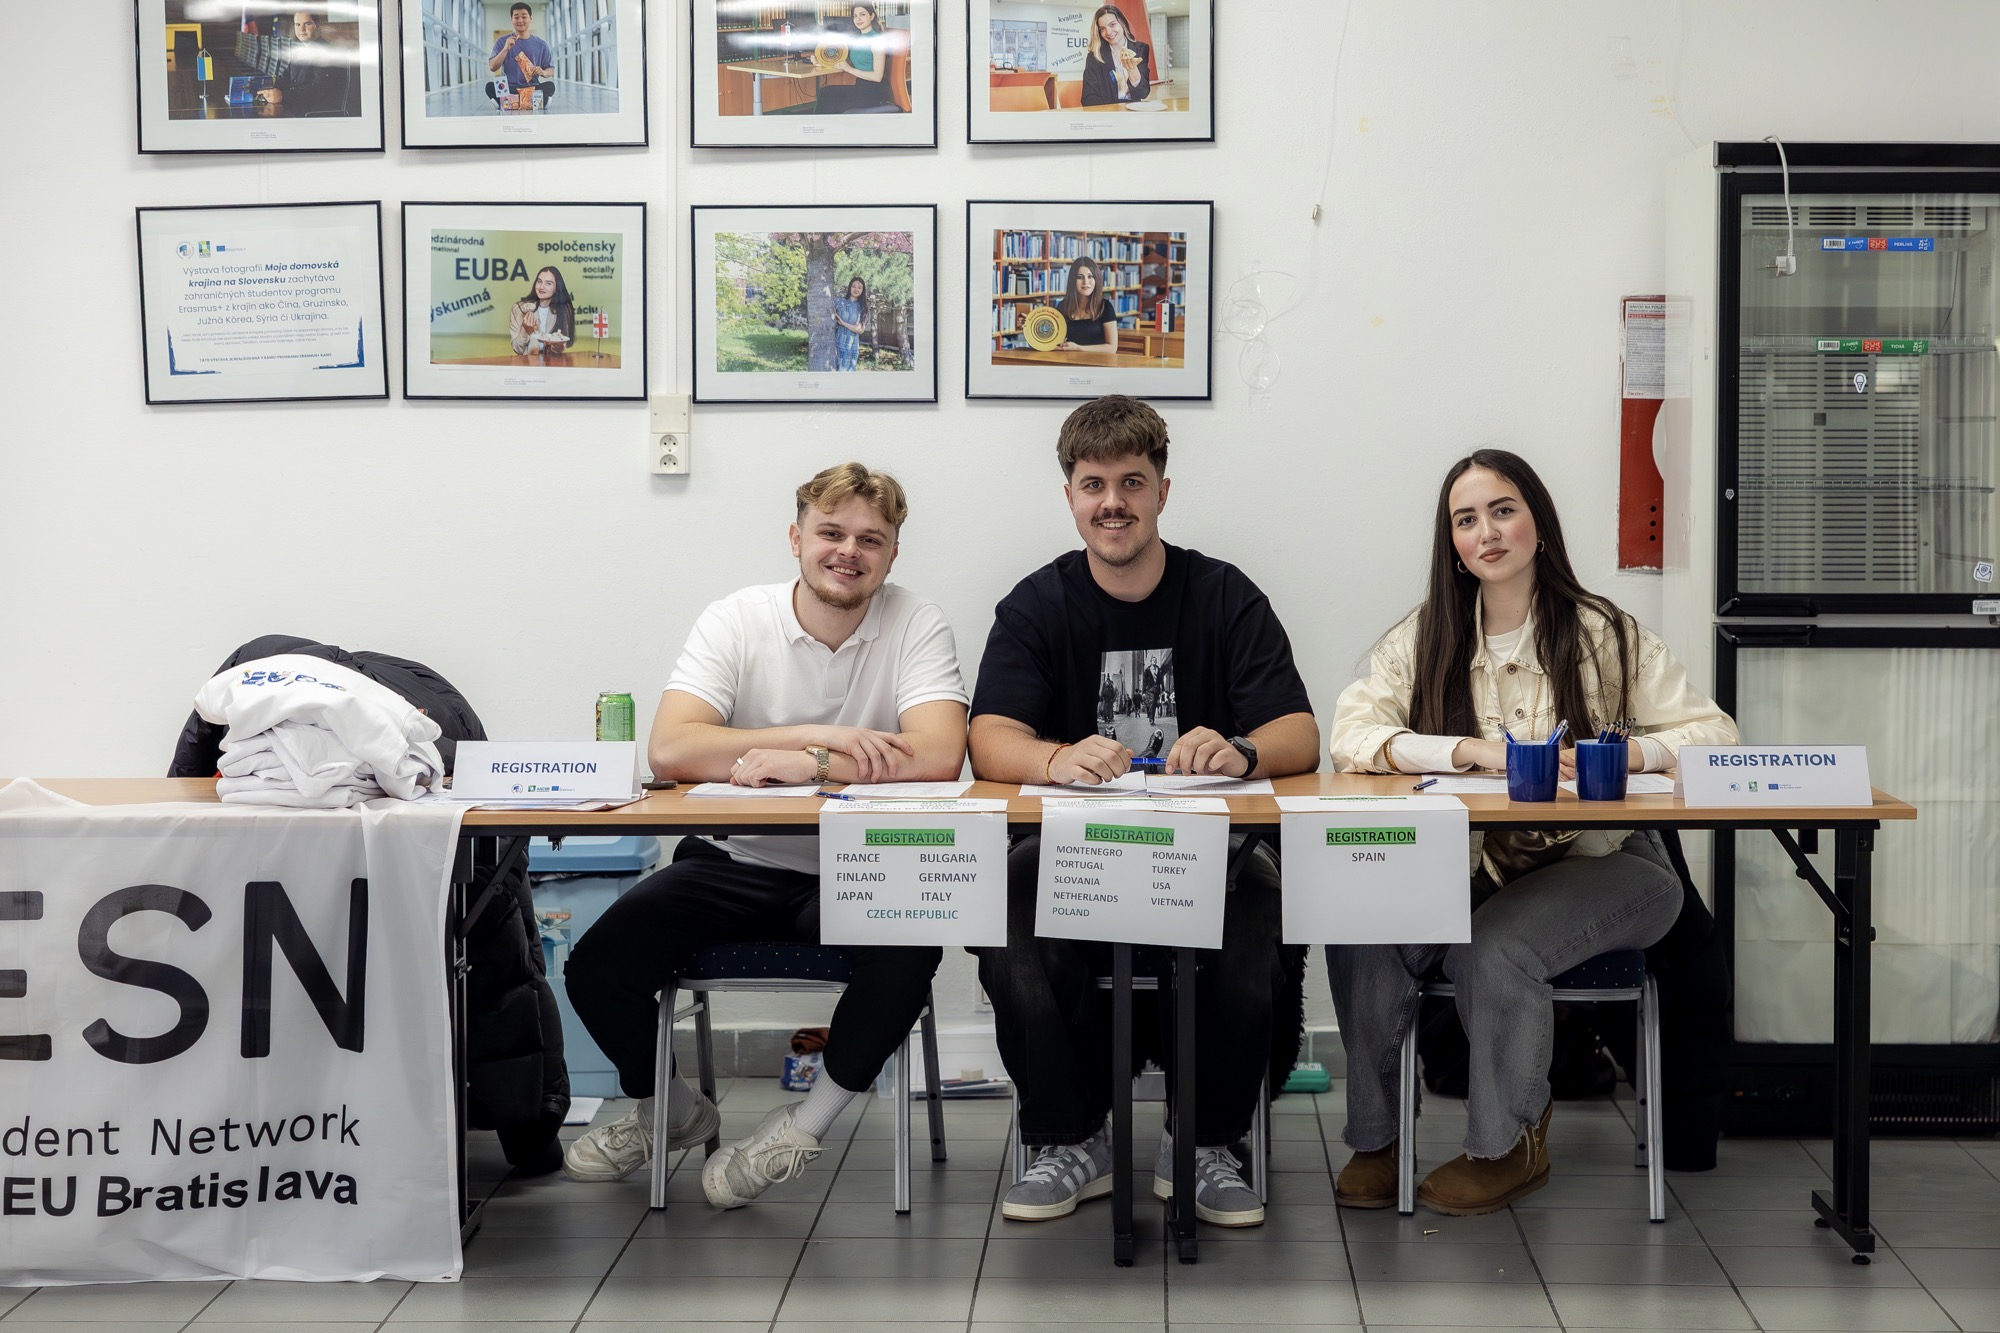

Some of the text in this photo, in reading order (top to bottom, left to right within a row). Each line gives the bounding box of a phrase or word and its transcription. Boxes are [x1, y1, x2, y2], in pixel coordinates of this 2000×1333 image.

[537, 240, 616, 254] spoločensky
[563, 255, 614, 263] zodpovedná
[183, 266, 219, 277] Výstava
[265, 263, 288, 273] Moja
[289, 260, 340, 270] domovská
[456, 258, 528, 281] EUBA
[583, 266, 614, 274] socially
[188, 278, 222, 289] krajina
[238, 276, 286, 285] Slovensku
[288, 274, 335, 285] zachytáva
[184, 287, 341, 301] zahraničných študentov programu
[179, 304, 223, 314] Erasmus+
[259, 301, 276, 310] ako
[197, 316, 223, 326] Južná
[256, 314, 278, 324] Sýria
[291, 312, 329, 322] Ukrajina.
[1708, 754, 1836, 766] REGISTRATION
[491, 763, 597, 773] REGISTRATION
[865, 833, 955, 843] REGISTRATION
[1085, 827, 1174, 843] REGISTRATION
[1326, 831, 1416, 843] REGISTRATION
[837, 854, 977, 863] FRANCE BULGARIA
[1056, 845, 1197, 862] MONTENEGRO ROMANIA
[1351, 852, 1386, 862] SPAIN
[1055, 860, 1187, 875] PORTUGAL TURKEY
[837, 873, 977, 882] FINLAND GERMANY
[1054, 876, 1171, 890] SLOVANIA USA
[836, 892, 952, 901] JAPAN ITALY
[1053, 891, 1194, 908] NETHERLANDS VIETNAM
[866, 910, 959, 919] CZECH REPUBLIC
[1052, 907, 1090, 917] POLAND
[2, 1104, 361, 1157] dent Network
[2, 1165, 359, 1218] EU Bratislava
